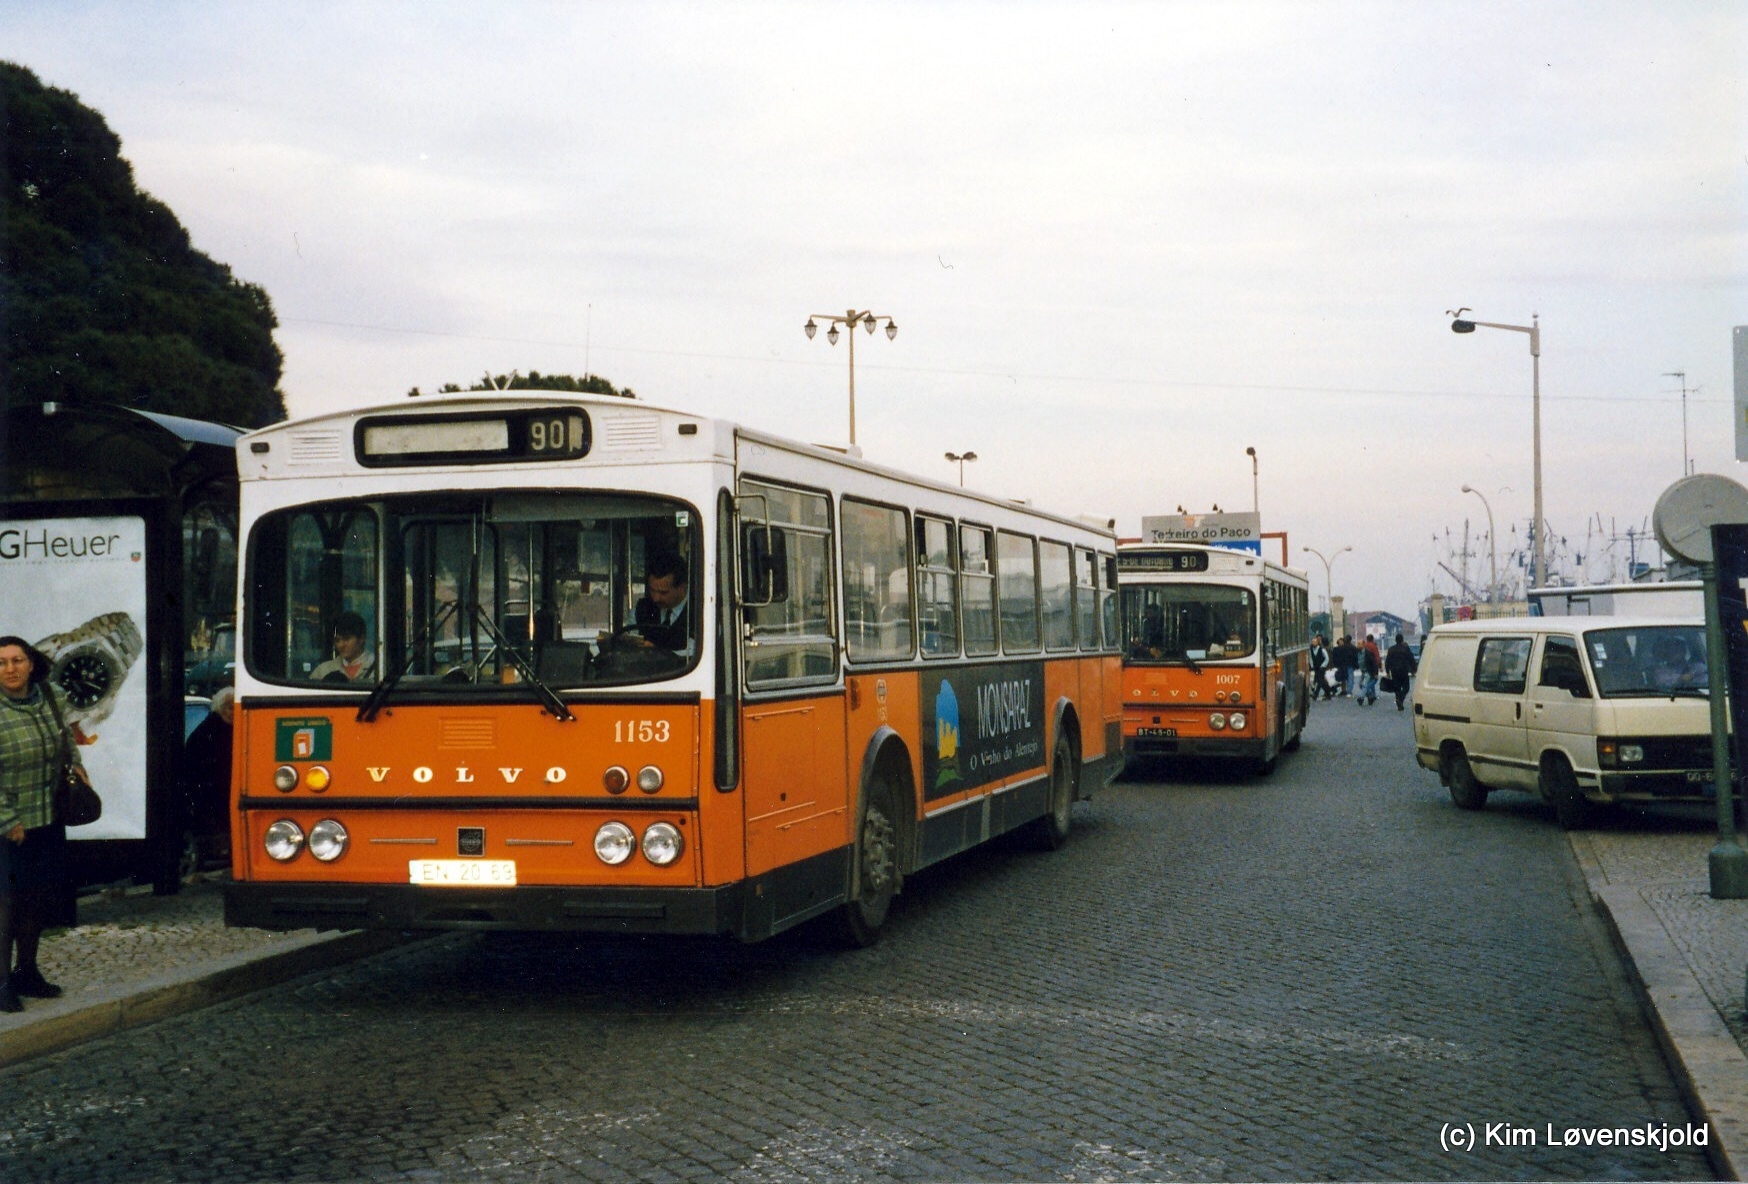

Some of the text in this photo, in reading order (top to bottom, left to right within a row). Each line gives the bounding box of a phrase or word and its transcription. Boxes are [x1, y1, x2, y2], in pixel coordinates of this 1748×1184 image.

[531, 420, 565, 451] 90
[1202, 528, 1217, 539] do
[1181, 555, 1197, 568] 90
[1216, 674, 1240, 685] 1007
[1132, 688, 1198, 698] OLVO
[977, 679, 1031, 739] MONSARAZ
[614, 719, 670, 743] 1153
[366, 766, 567, 783] VOLVO
[460, 863, 480, 881] 20
